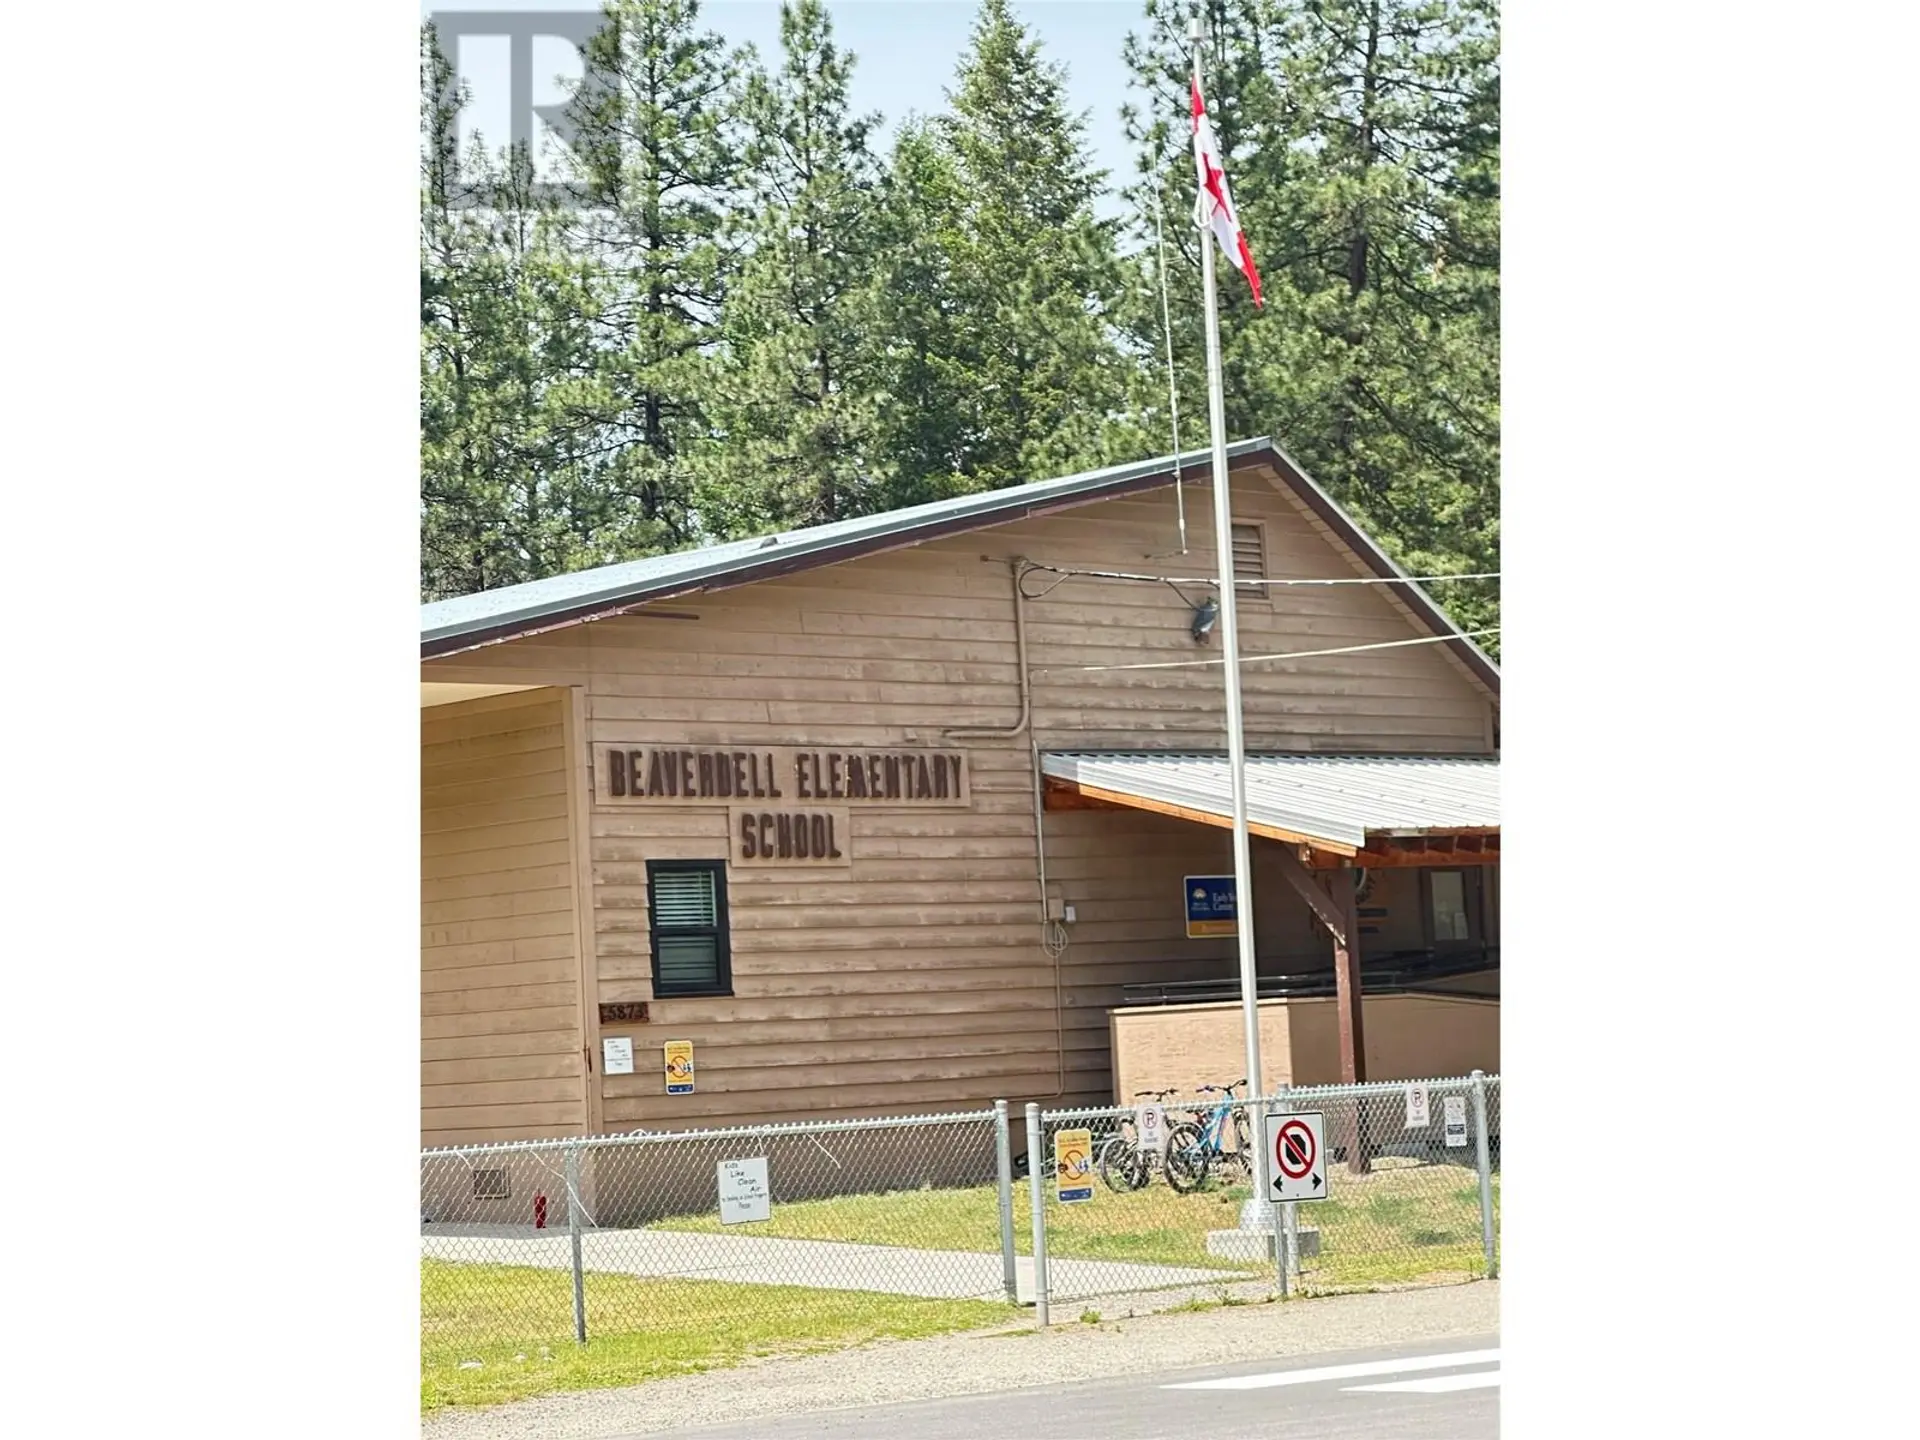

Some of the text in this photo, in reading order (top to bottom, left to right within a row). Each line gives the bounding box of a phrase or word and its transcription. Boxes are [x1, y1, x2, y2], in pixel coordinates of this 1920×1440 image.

[608, 749, 962, 799] BEAVERDELL ELEMENTARY
[740, 812, 842, 859] SCHOOL
